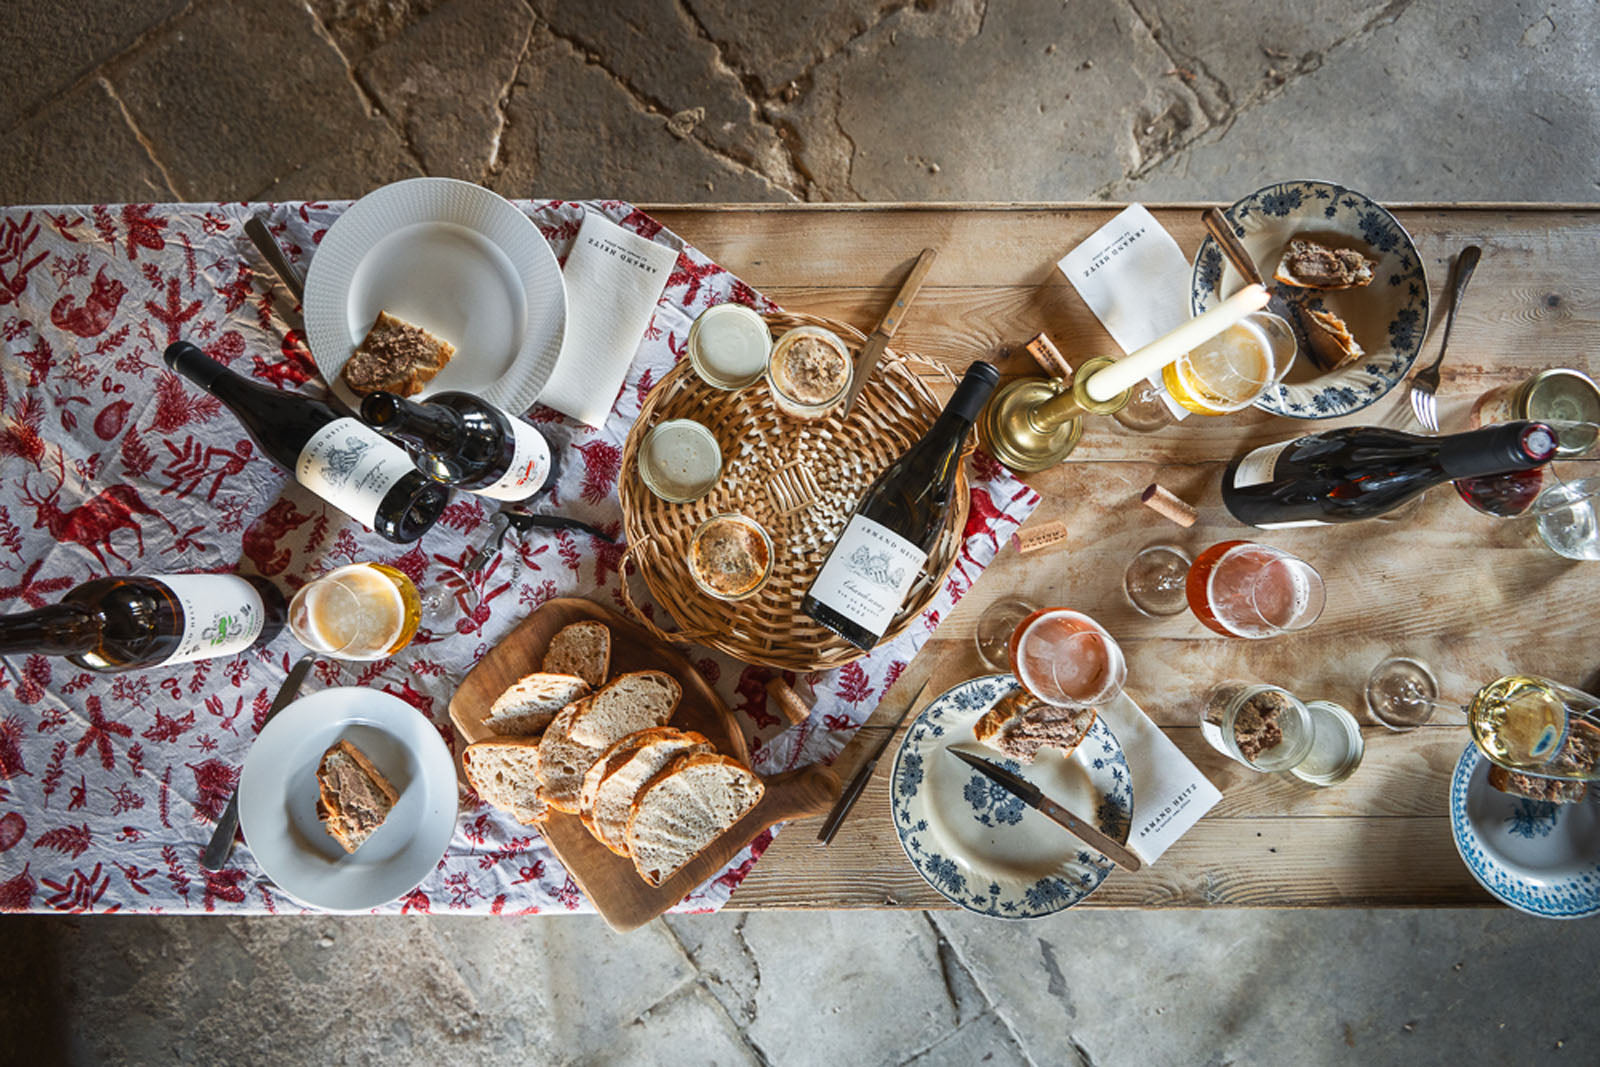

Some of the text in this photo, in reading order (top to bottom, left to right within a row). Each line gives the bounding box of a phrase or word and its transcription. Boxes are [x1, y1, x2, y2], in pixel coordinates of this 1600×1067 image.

[588, 238, 616, 256] HEITZ
[1111, 228, 1146, 256] ARMAND
[620, 254, 657, 274] ARMAND
[1083, 255, 1110, 277] HEITZ
[861, 526, 898, 548] ARMAND
[1139, 806, 1172, 837] ARMAND
[1173, 783, 1197, 806] HEITZ
